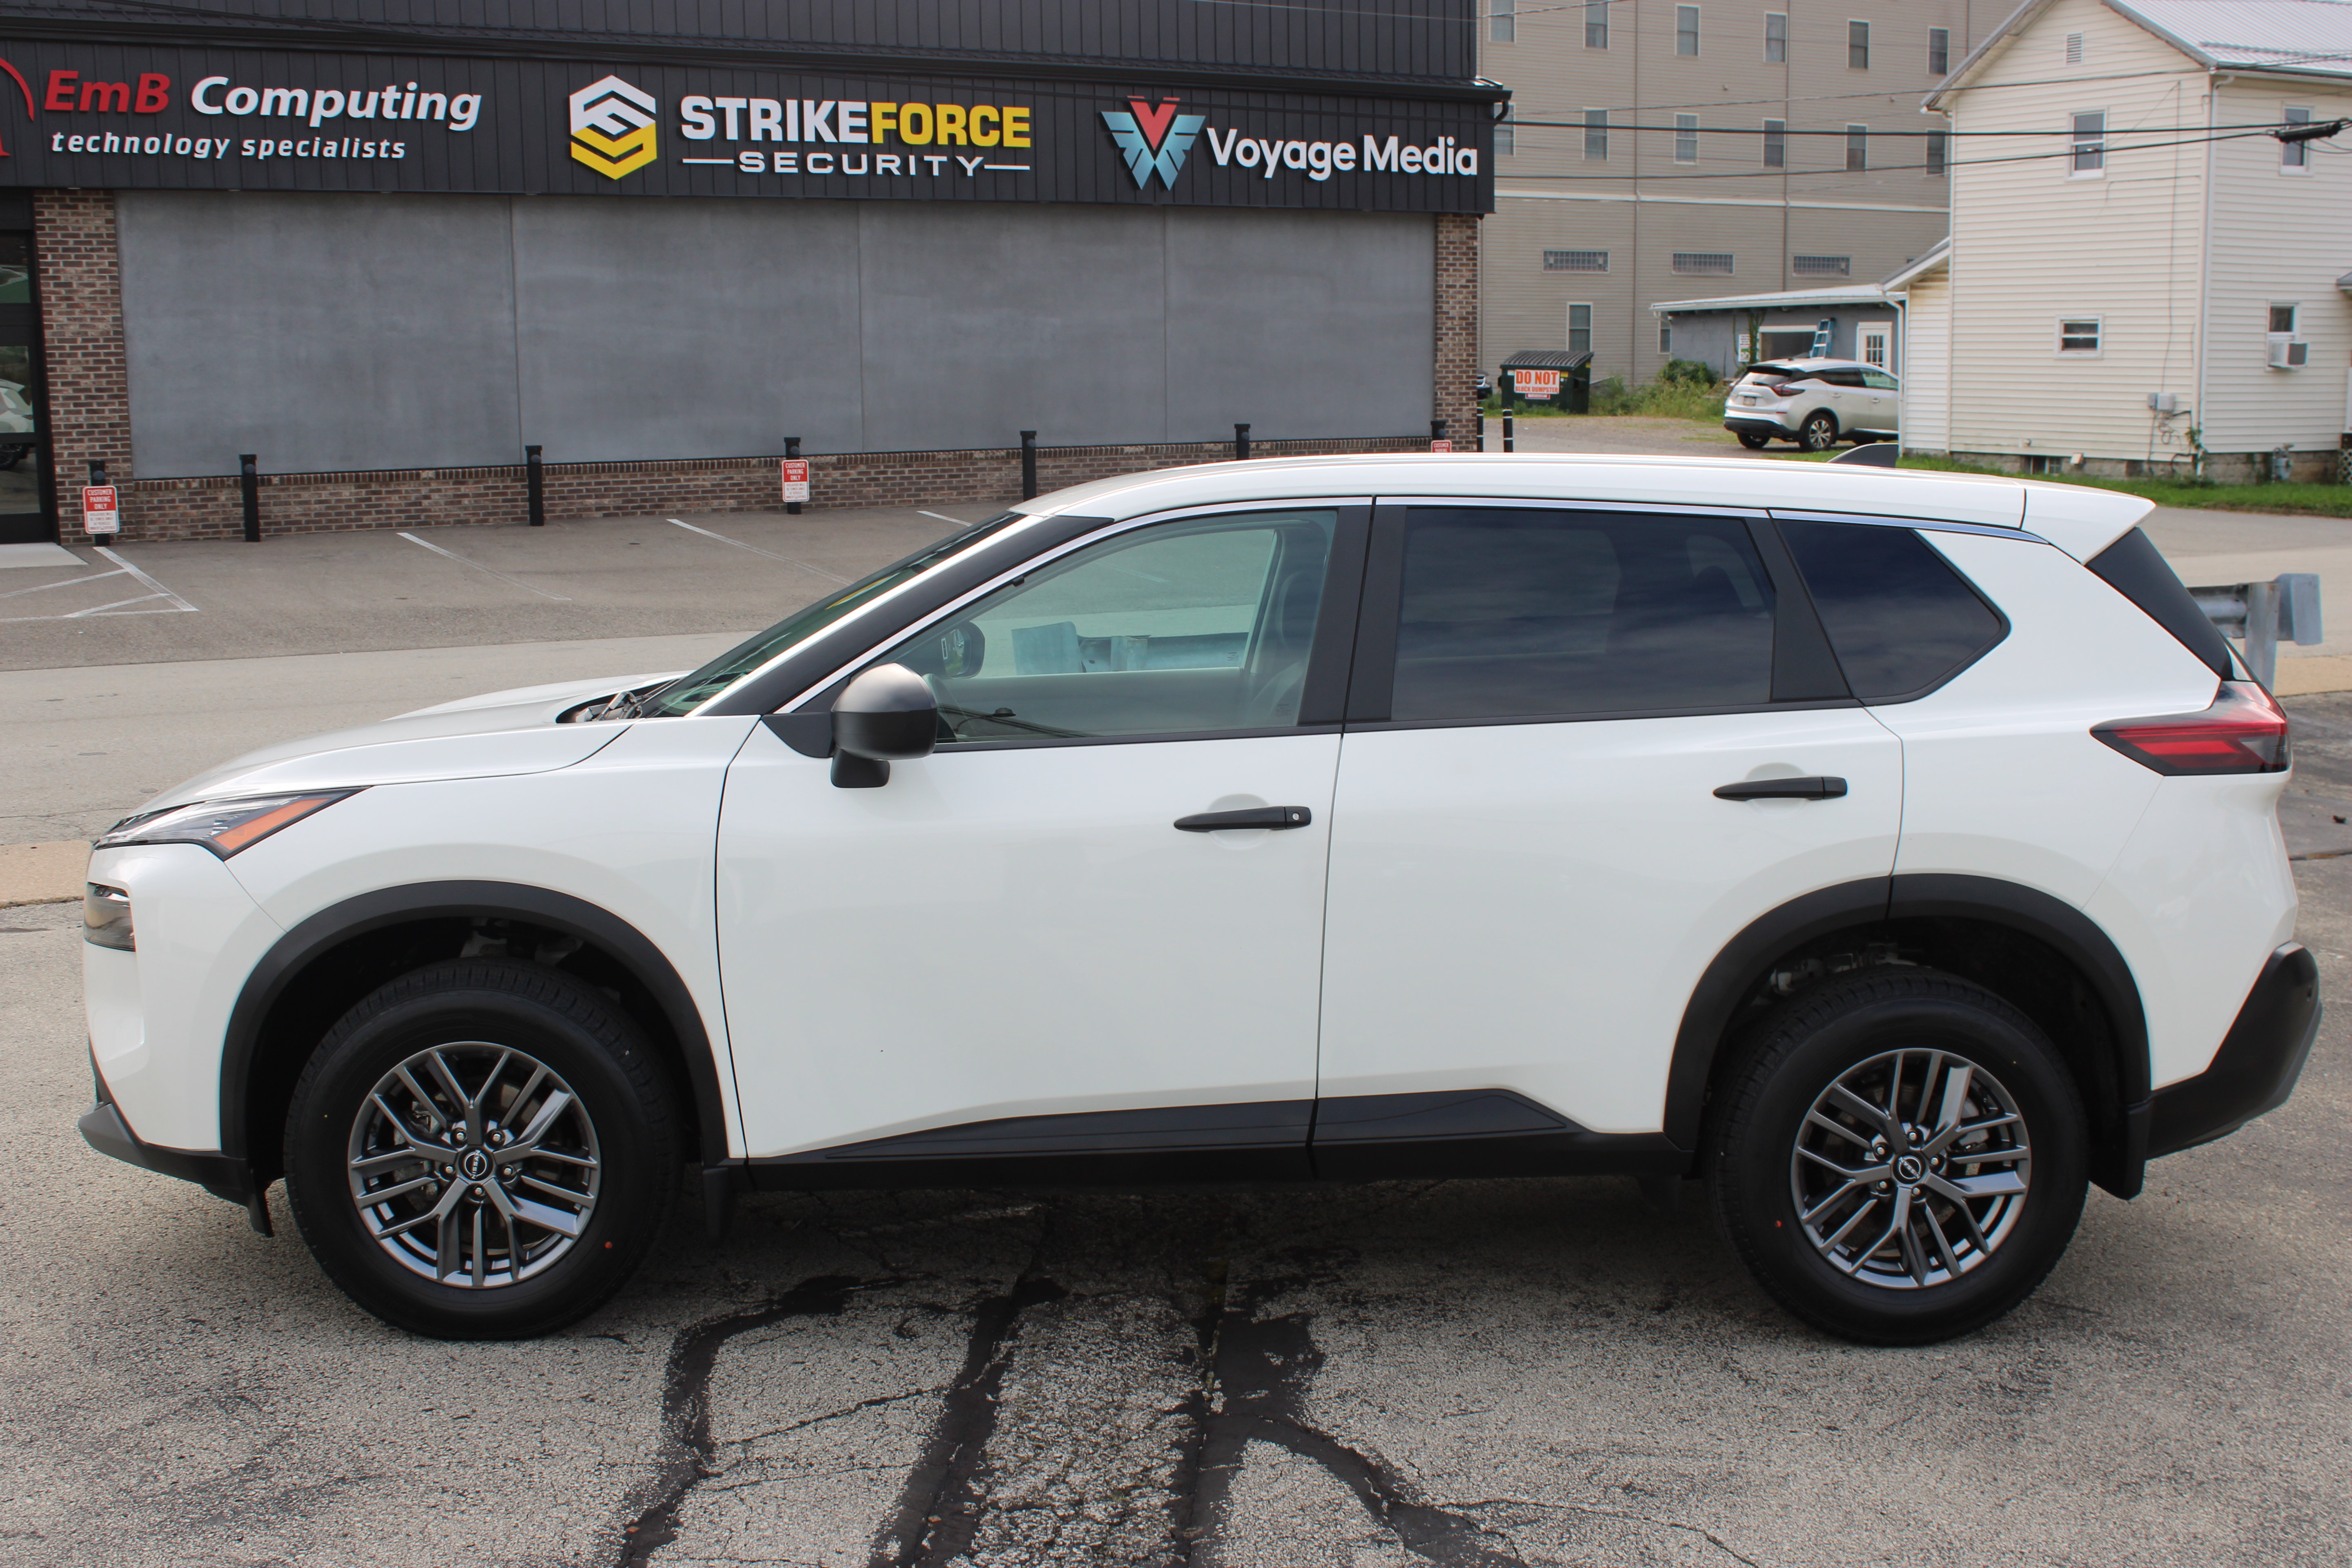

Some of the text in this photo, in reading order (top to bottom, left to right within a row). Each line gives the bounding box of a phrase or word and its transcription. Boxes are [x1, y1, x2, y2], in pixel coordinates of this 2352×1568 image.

[45, 70, 481, 131] EmB Computing
[681, 96, 1031, 147] STRIKEFORCE
[52, 132, 405, 160] technology specialists
[1207, 127, 1477, 180] Voyage Media
[739, 151, 983, 176] SECURITY
[1516, 371, 1558, 385] DO NOT
[471, 1149, 481, 1179] NISSAN
[1898, 1156, 1920, 1179] NISSAN
